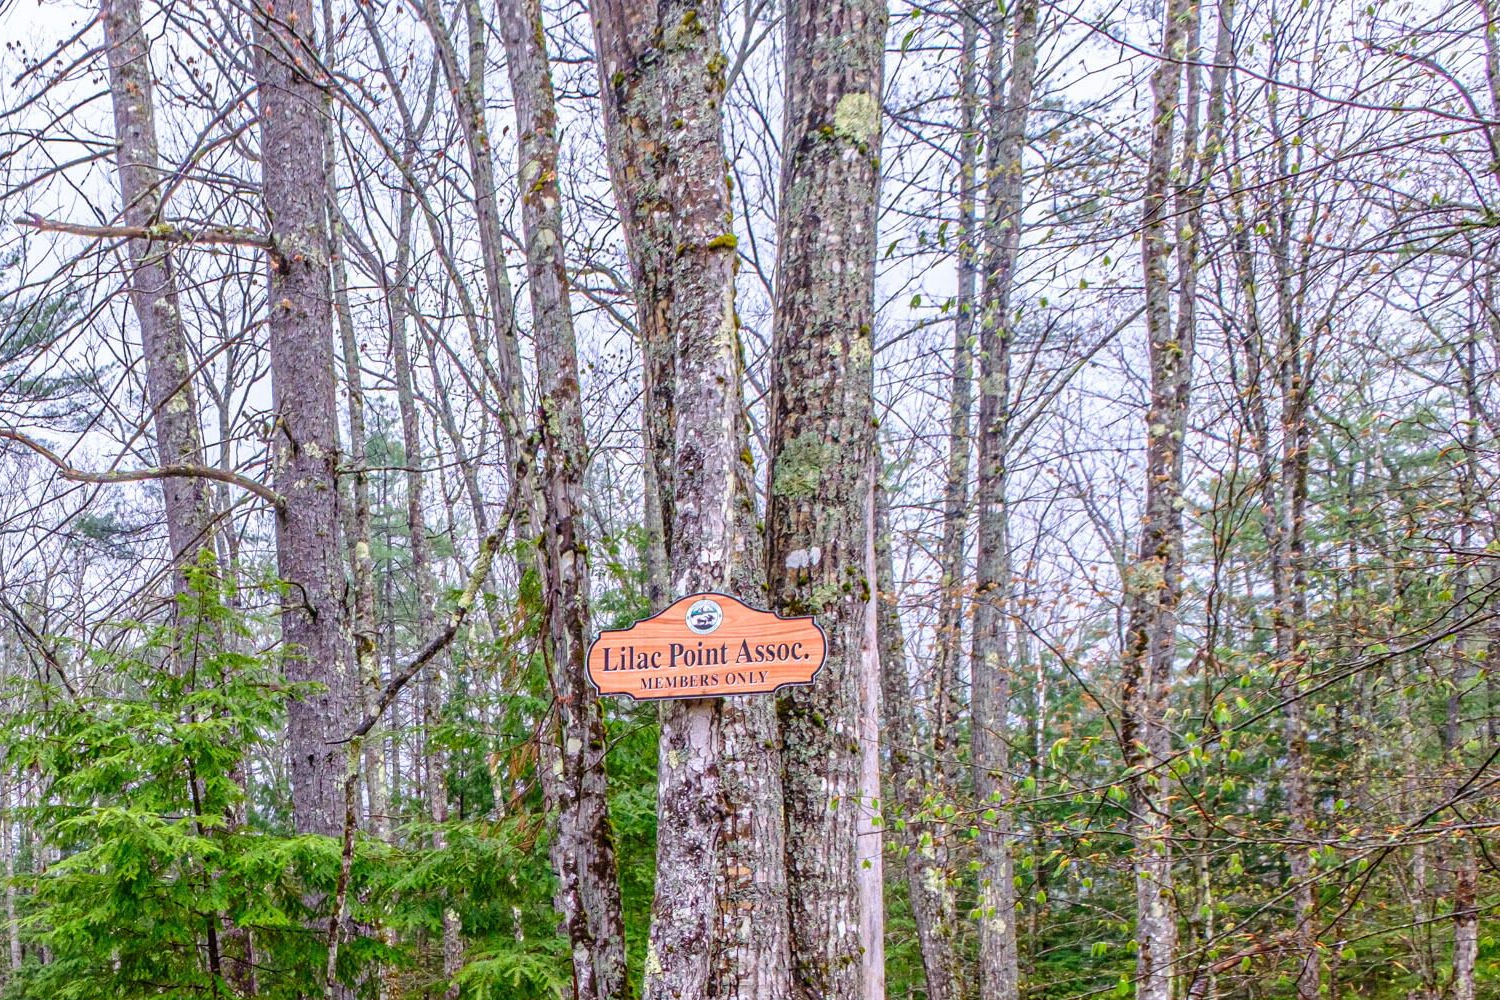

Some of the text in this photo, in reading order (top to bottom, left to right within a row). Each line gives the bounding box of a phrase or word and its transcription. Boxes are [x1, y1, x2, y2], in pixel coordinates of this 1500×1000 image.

[602, 638, 810, 672] Lilac Point Assoc.
[640, 670, 769, 690] MEMBERS ONLY
